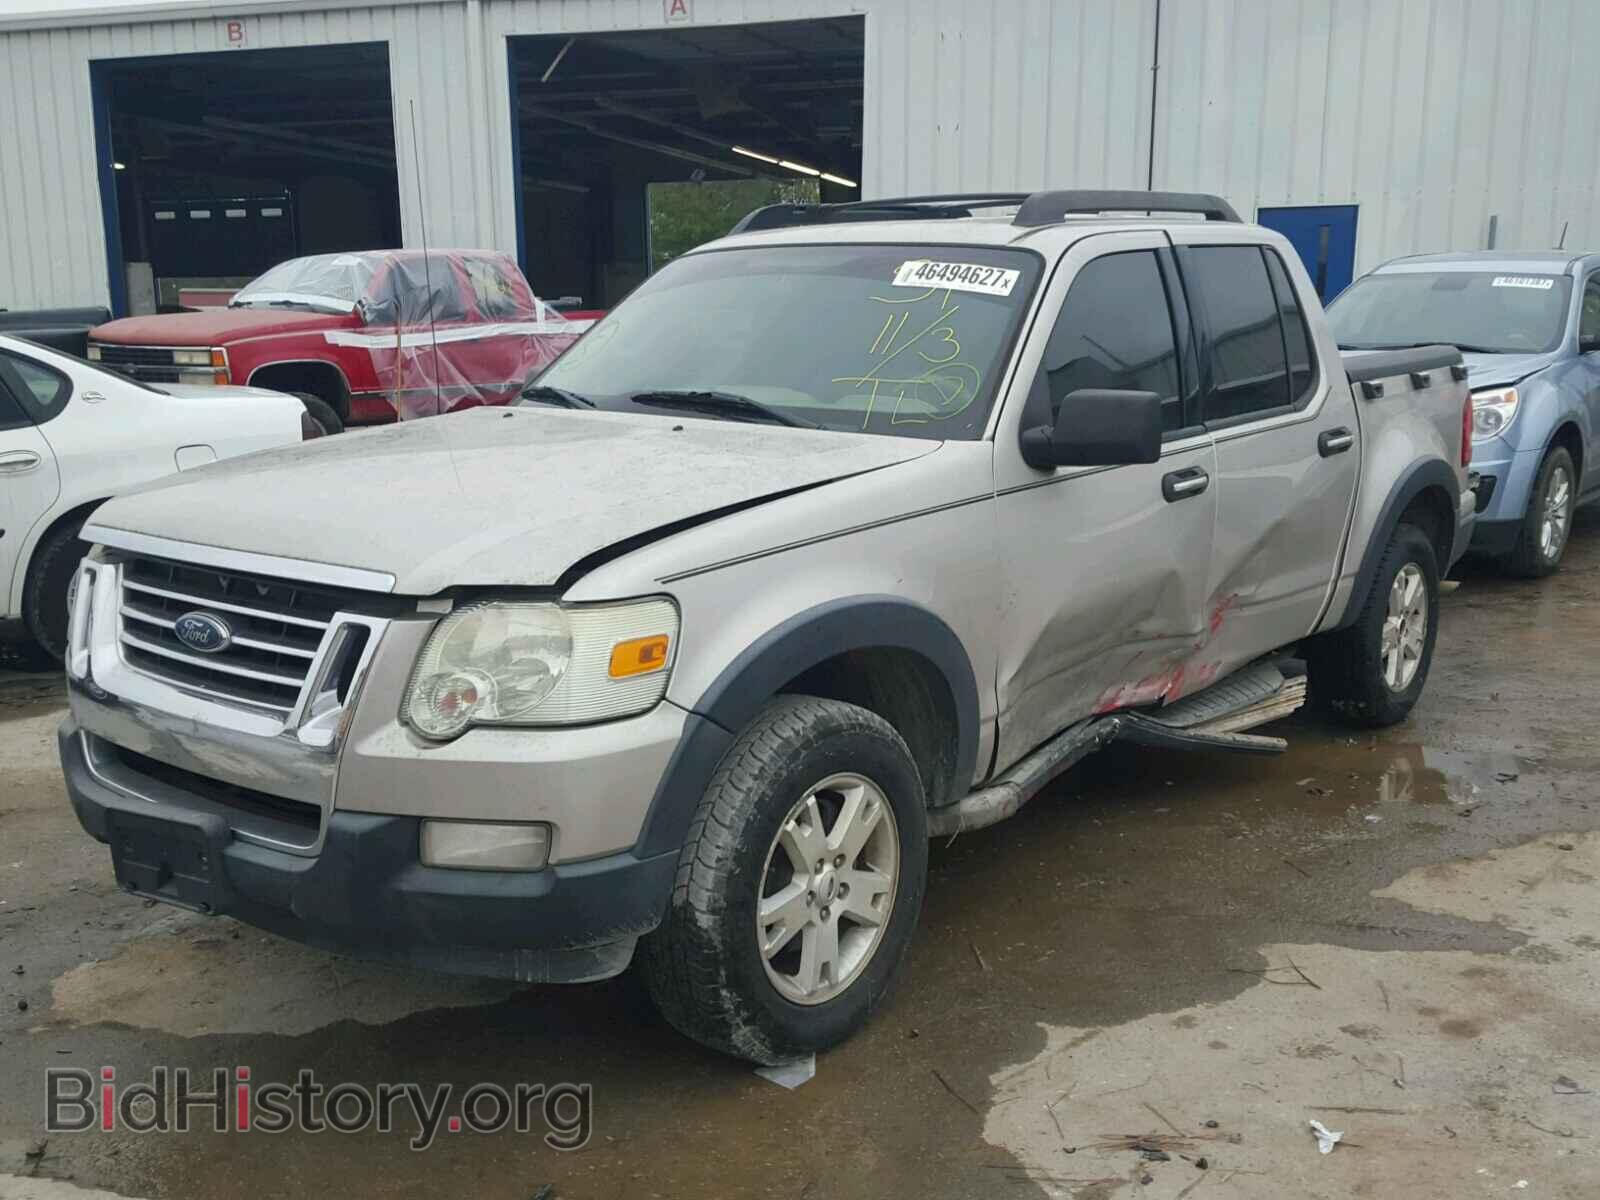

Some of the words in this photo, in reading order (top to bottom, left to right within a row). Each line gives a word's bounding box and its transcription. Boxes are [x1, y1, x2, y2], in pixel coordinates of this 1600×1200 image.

[670, 0, 687, 16] A
[227, 21, 242, 42] B
[182, 619, 210, 642] Ford
